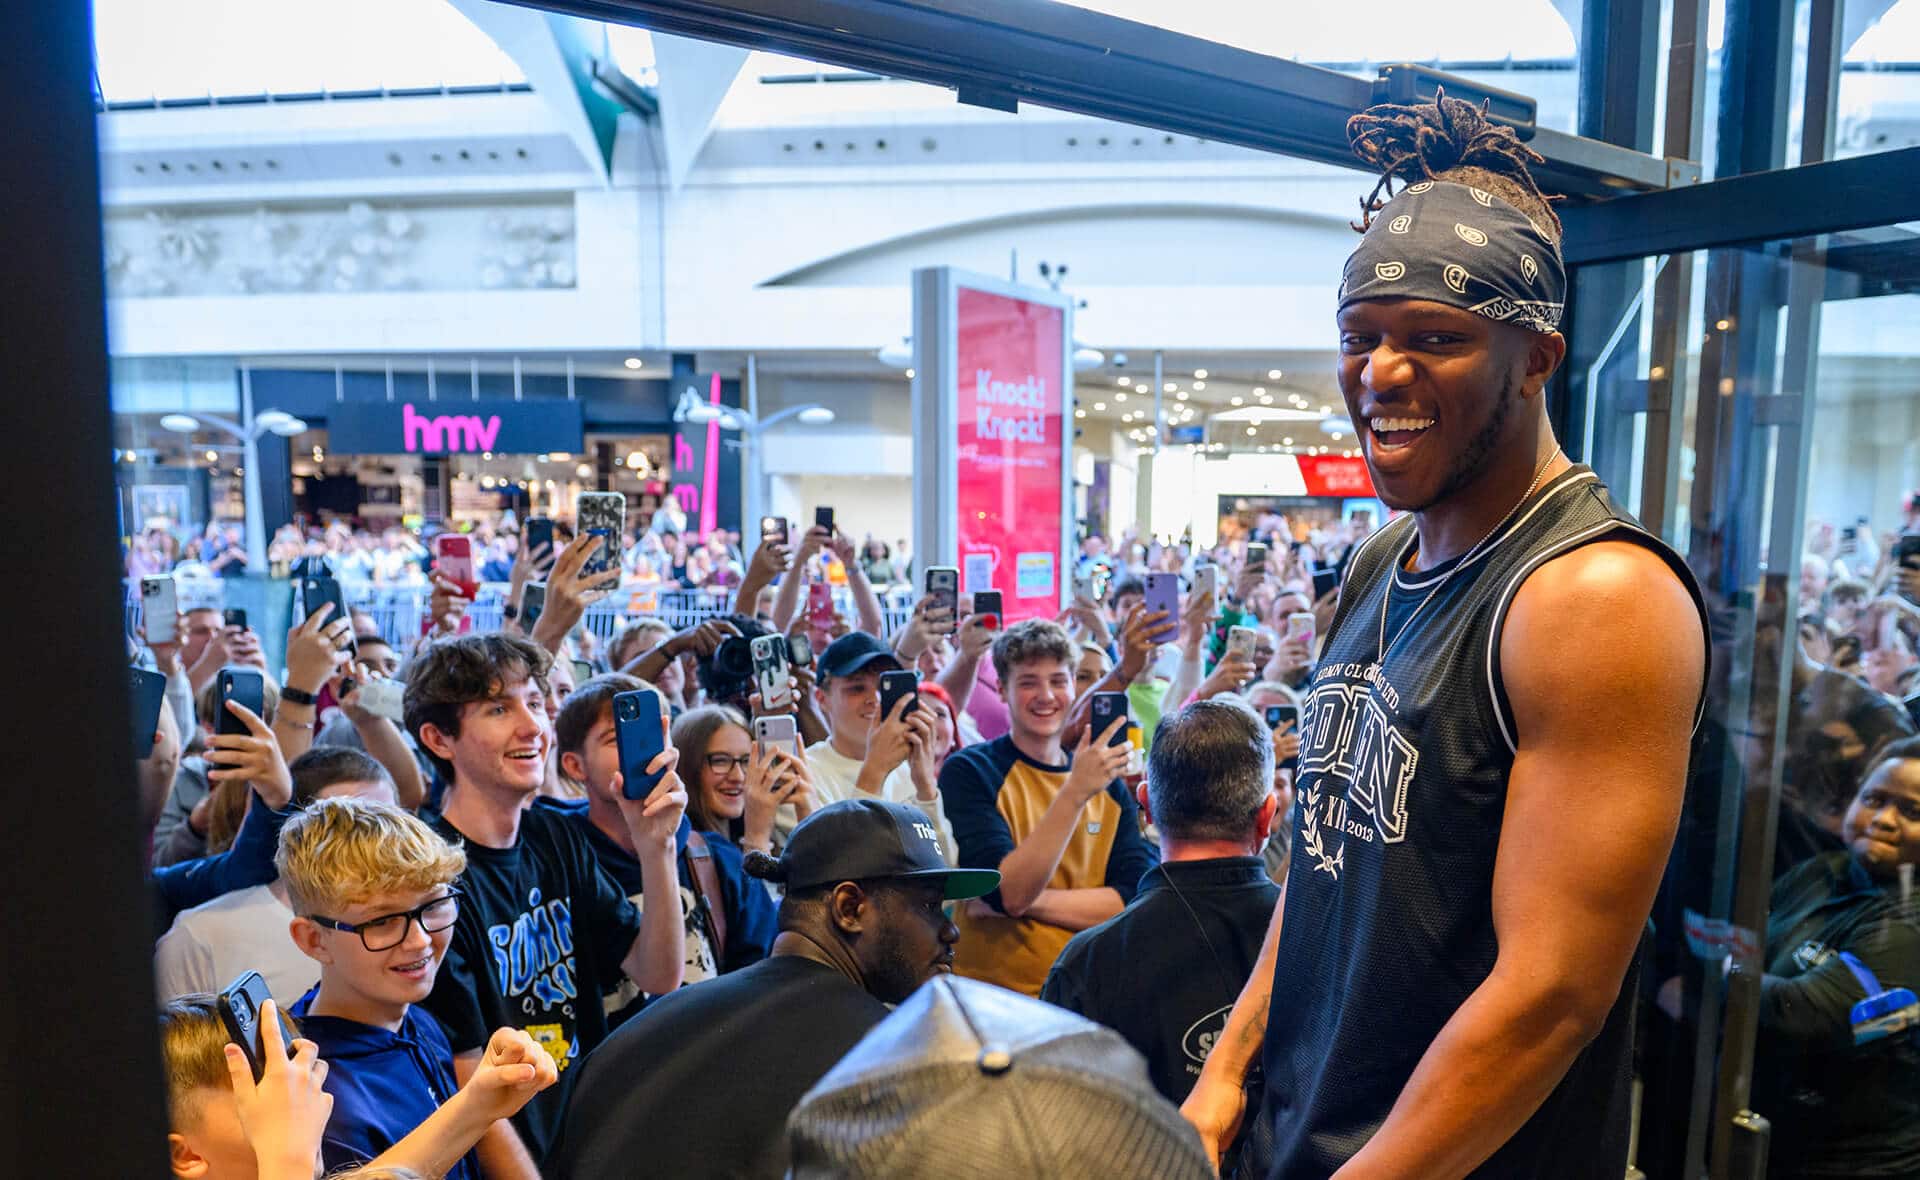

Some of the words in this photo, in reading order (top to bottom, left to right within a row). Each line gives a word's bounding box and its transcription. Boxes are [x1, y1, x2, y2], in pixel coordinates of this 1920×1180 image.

[976, 368, 1045, 409] Knock!
[403, 403, 501, 453] hmv
[976, 405, 1045, 444] Knock!
[1346, 820, 1374, 843] 2013
